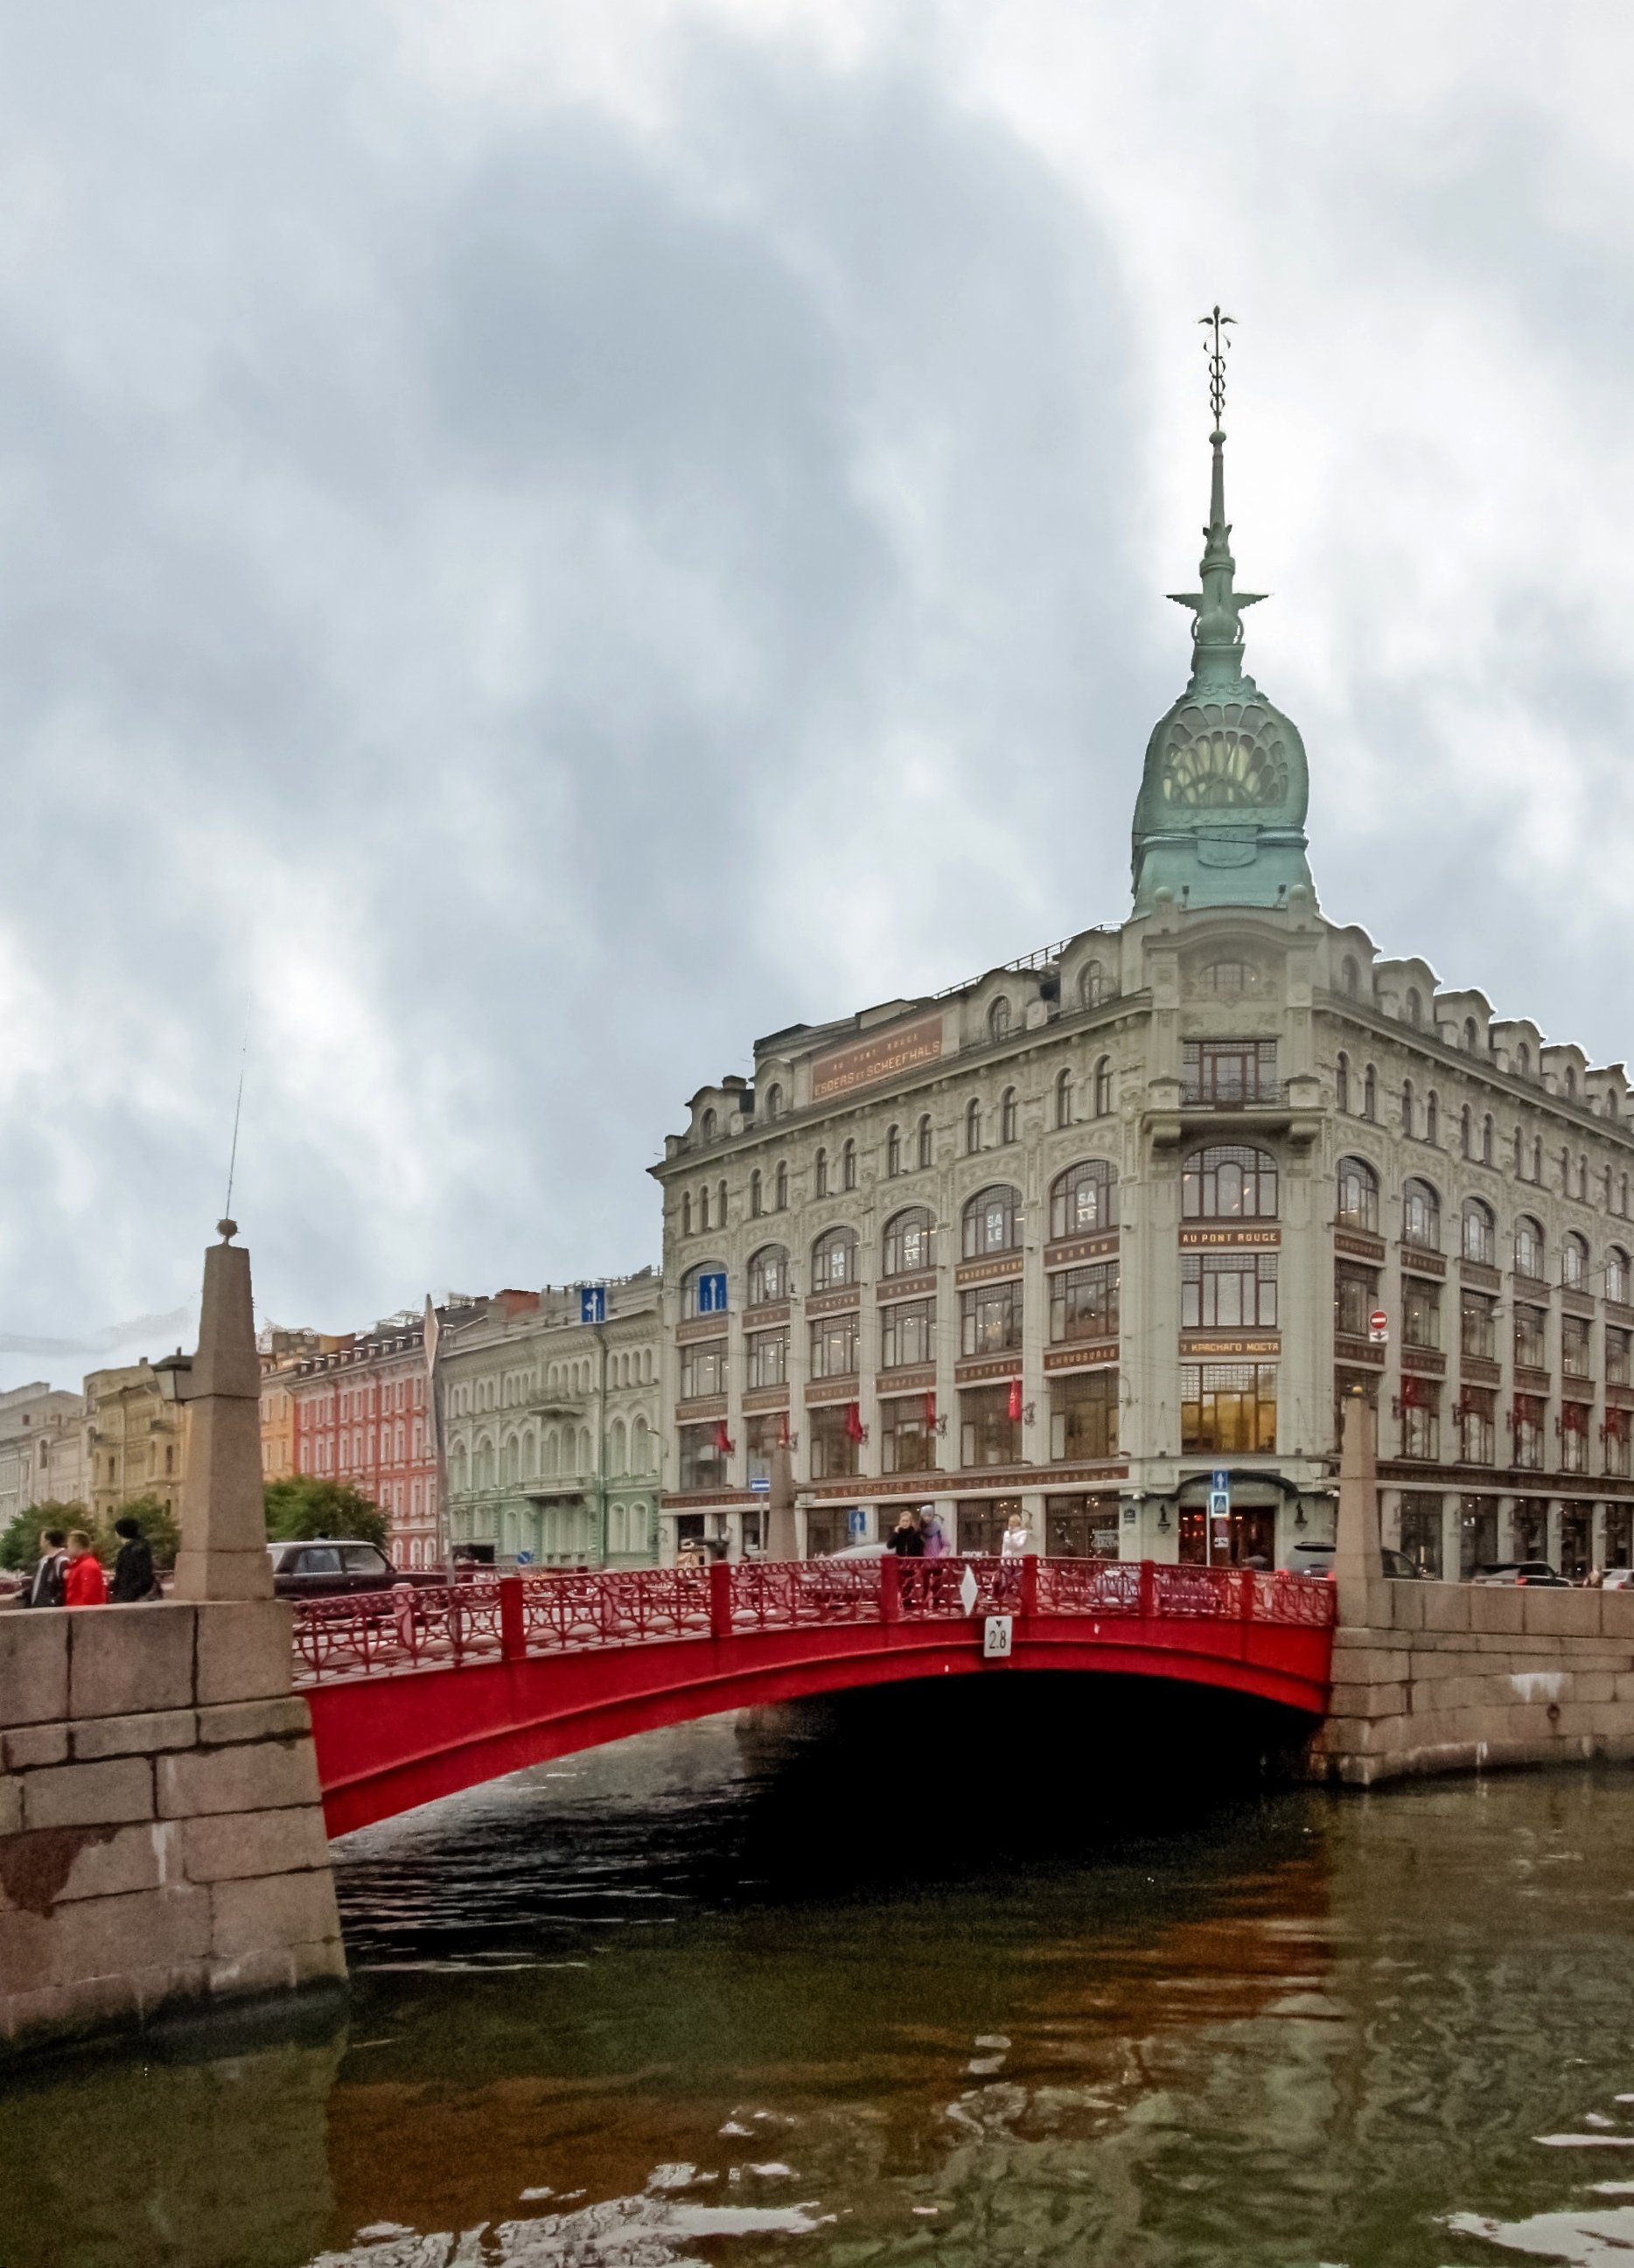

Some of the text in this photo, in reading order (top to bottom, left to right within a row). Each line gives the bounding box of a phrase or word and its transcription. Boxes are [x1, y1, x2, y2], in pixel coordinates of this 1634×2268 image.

[814, 1072, 855, 1096] ESDERS
[866, 1040, 940, 1078] SCHEEFHALS
[1078, 1192, 1096, 1207] SA
[987, 1213, 1002, 1228] SA
[988, 1228, 1002, 1242] LE
[1183, 1232, 1277, 1243] AU PONT ROUGE
[832, 1252, 845, 1265] SA
[832, 1265, 845, 1278] LE
[1191, 1343, 1242, 1352] КРАСНАГО
[1246, 1342, 1279, 1351] МОСТА
